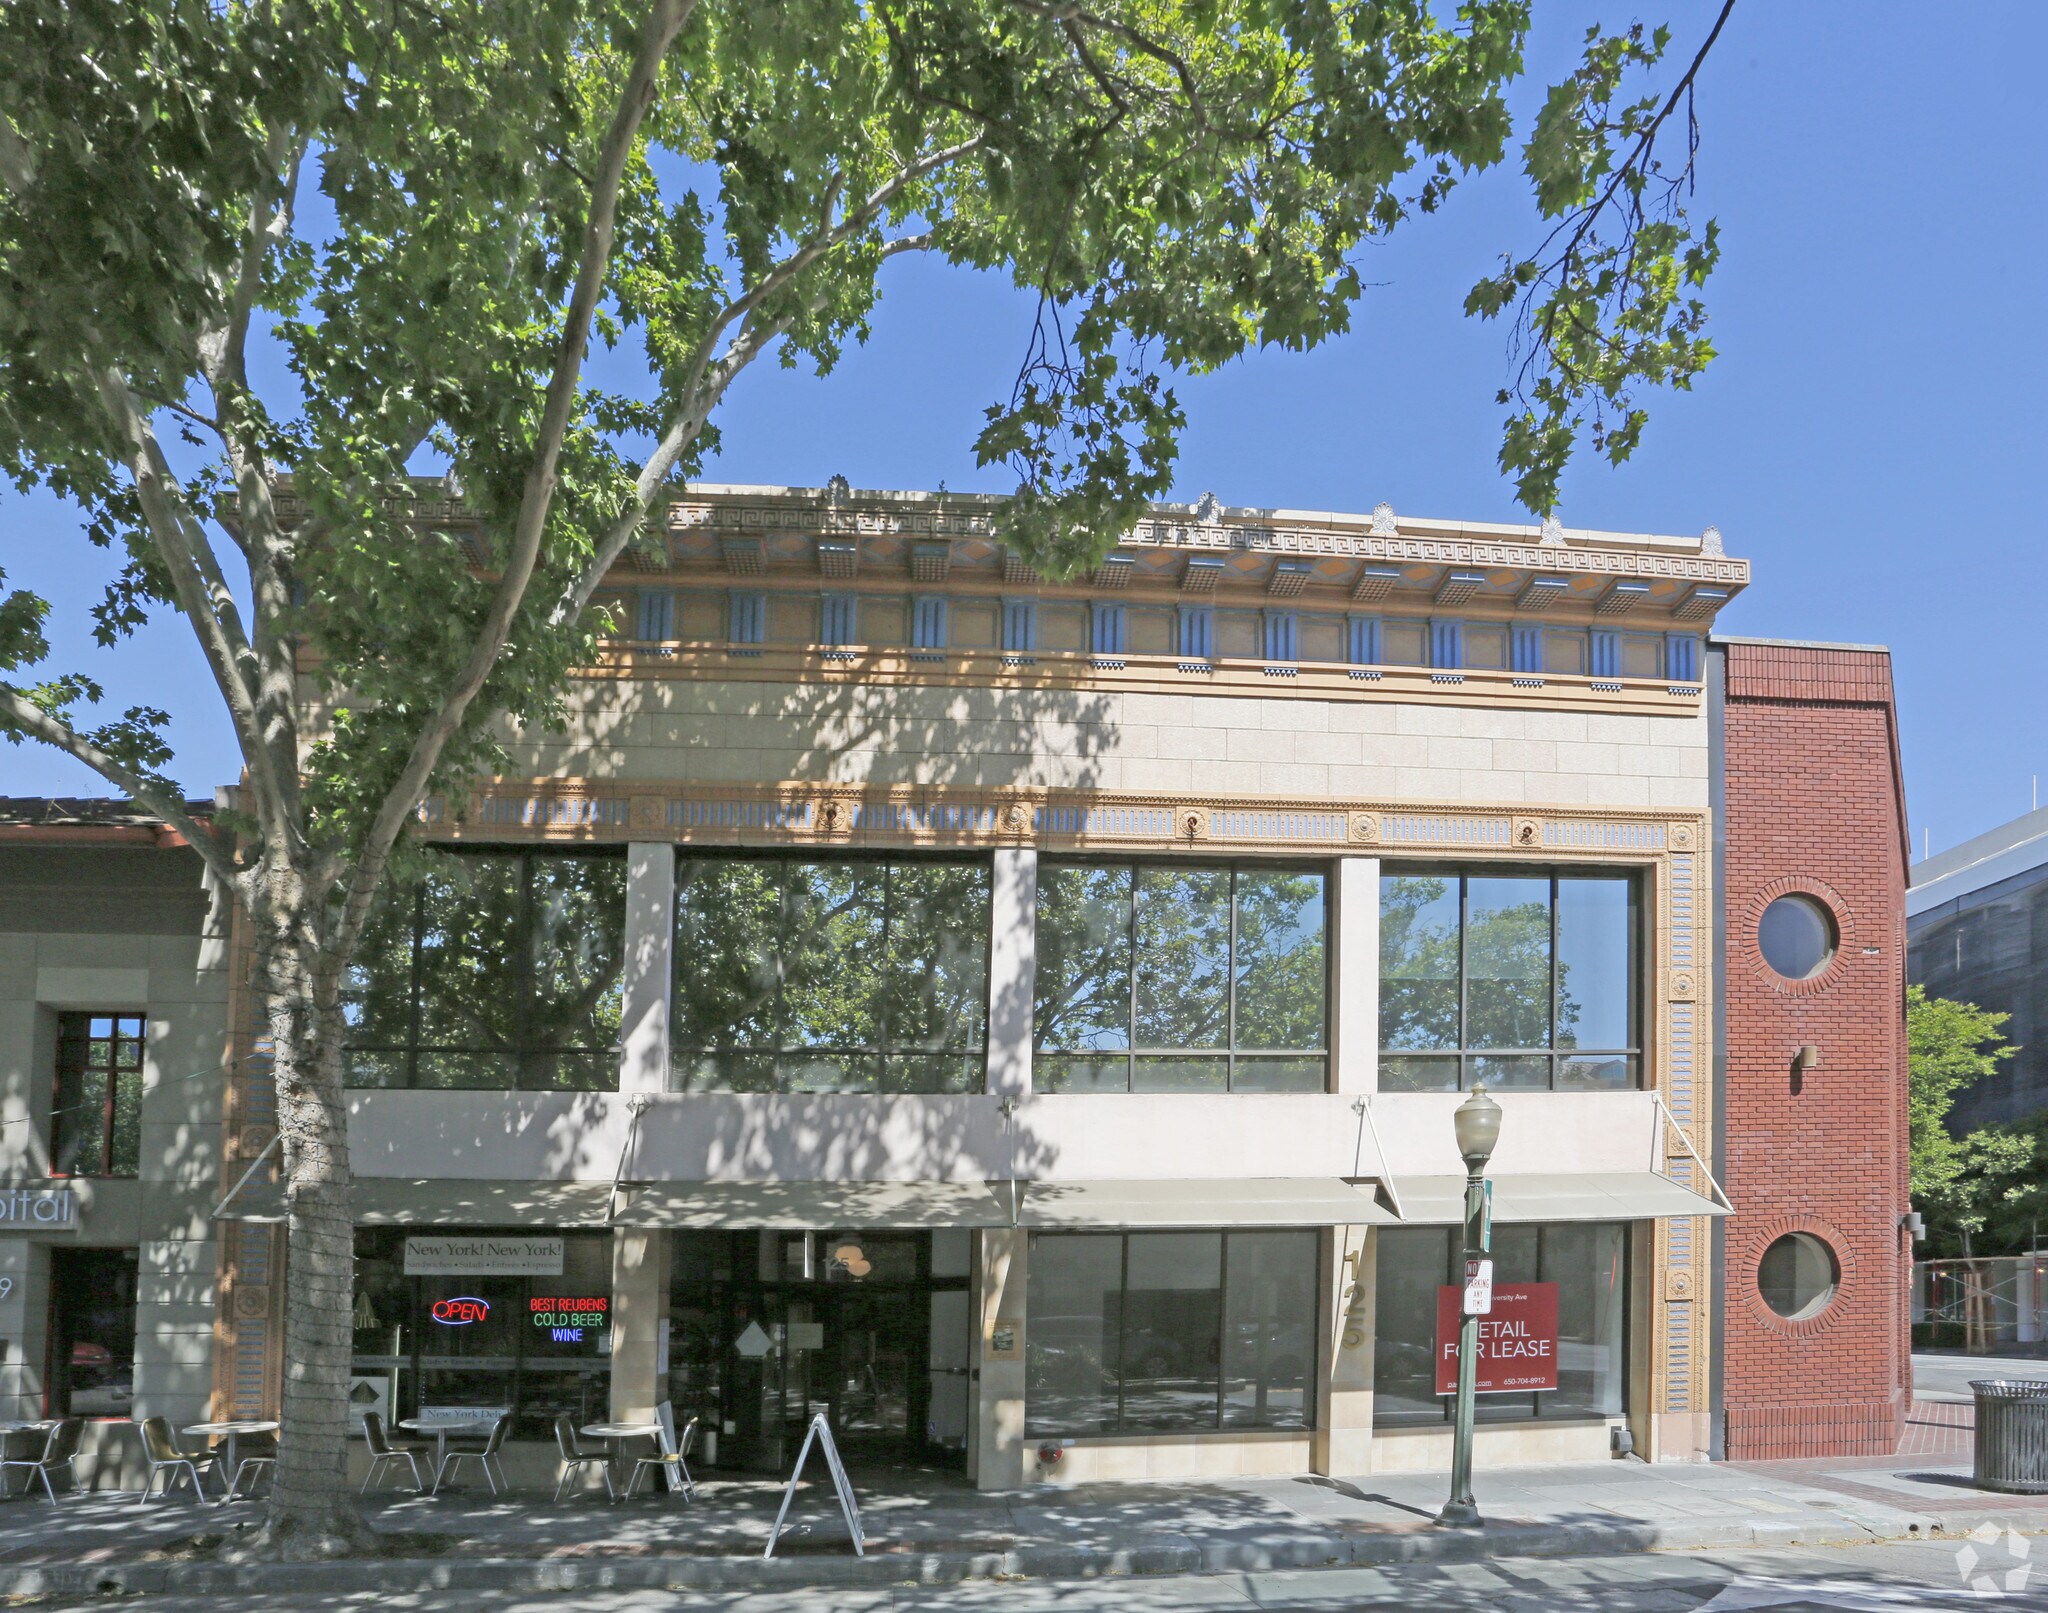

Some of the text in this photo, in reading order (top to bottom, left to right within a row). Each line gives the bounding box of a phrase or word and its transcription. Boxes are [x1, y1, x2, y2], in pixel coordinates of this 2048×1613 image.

[407, 1242, 561, 1256] New York! New York!
[1467, 1263, 1478, 1275] NO
[1468, 1279, 1489, 1288] PARKING
[530, 1298, 607, 1311] BEST REUBENS
[432, 1301, 487, 1322] OPEN
[534, 1313, 603, 1327] COLD BEER
[552, 1329, 583, 1342] WINE
[1479, 1320, 1531, 1338] ETAIL
[1491, 1339, 1551, 1358] LEASE
[428, 1409, 450, 1418] New
[454, 1410, 478, 1418] York
